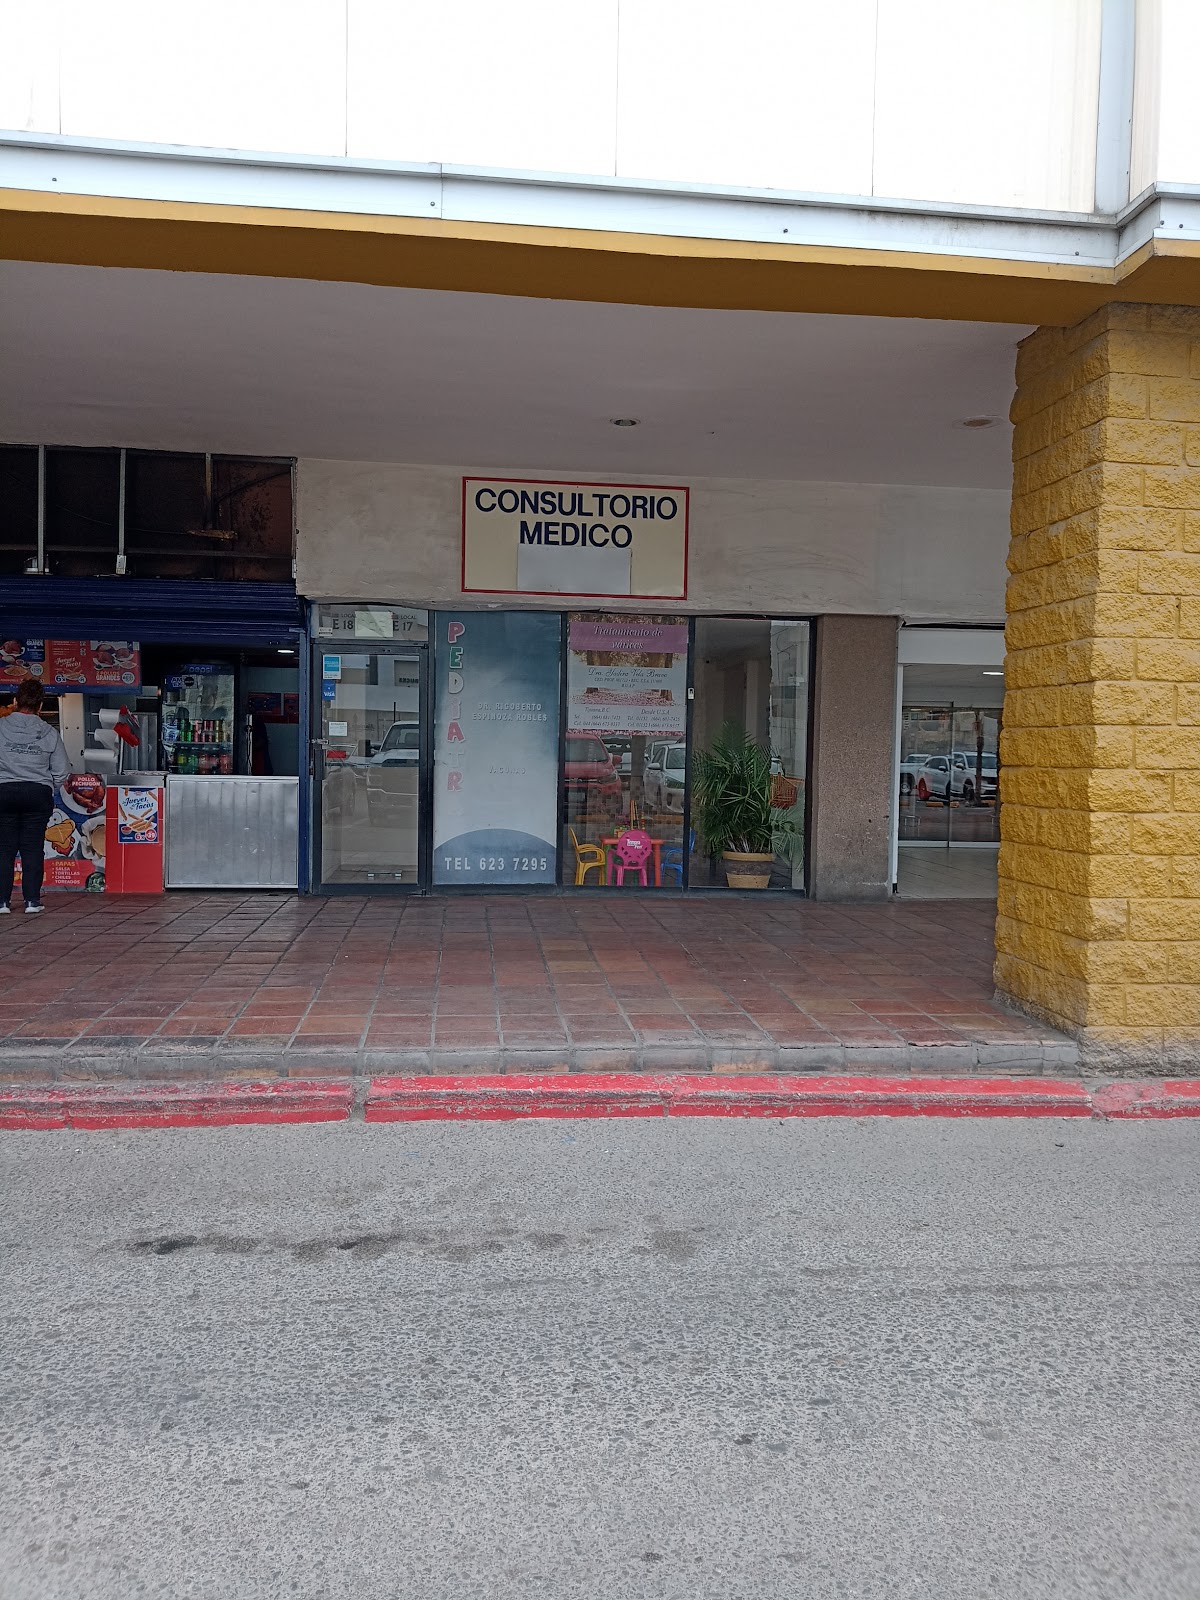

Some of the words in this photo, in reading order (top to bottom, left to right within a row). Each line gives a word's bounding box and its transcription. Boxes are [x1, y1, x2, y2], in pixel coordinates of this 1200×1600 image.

[475, 488, 678, 520] CONSULTORIO
[520, 521, 633, 548] MEDICO
[333, 619, 340, 630] E
[343, 620, 354, 630] 18
[392, 620, 399, 631] E
[403, 622, 413, 632] 17
[594, 625, 650, 636] Tratamiento
[652, 627, 664, 637] de
[447, 620, 466, 816] PEDIATR
[516, 713, 548, 722] ROBLES
[124, 797, 148, 807] Jueves
[135, 802, 154, 811] Tacos
[445, 857, 471, 871] TEL
[480, 857, 505, 871] 623
[513, 858, 548, 871] 7295
